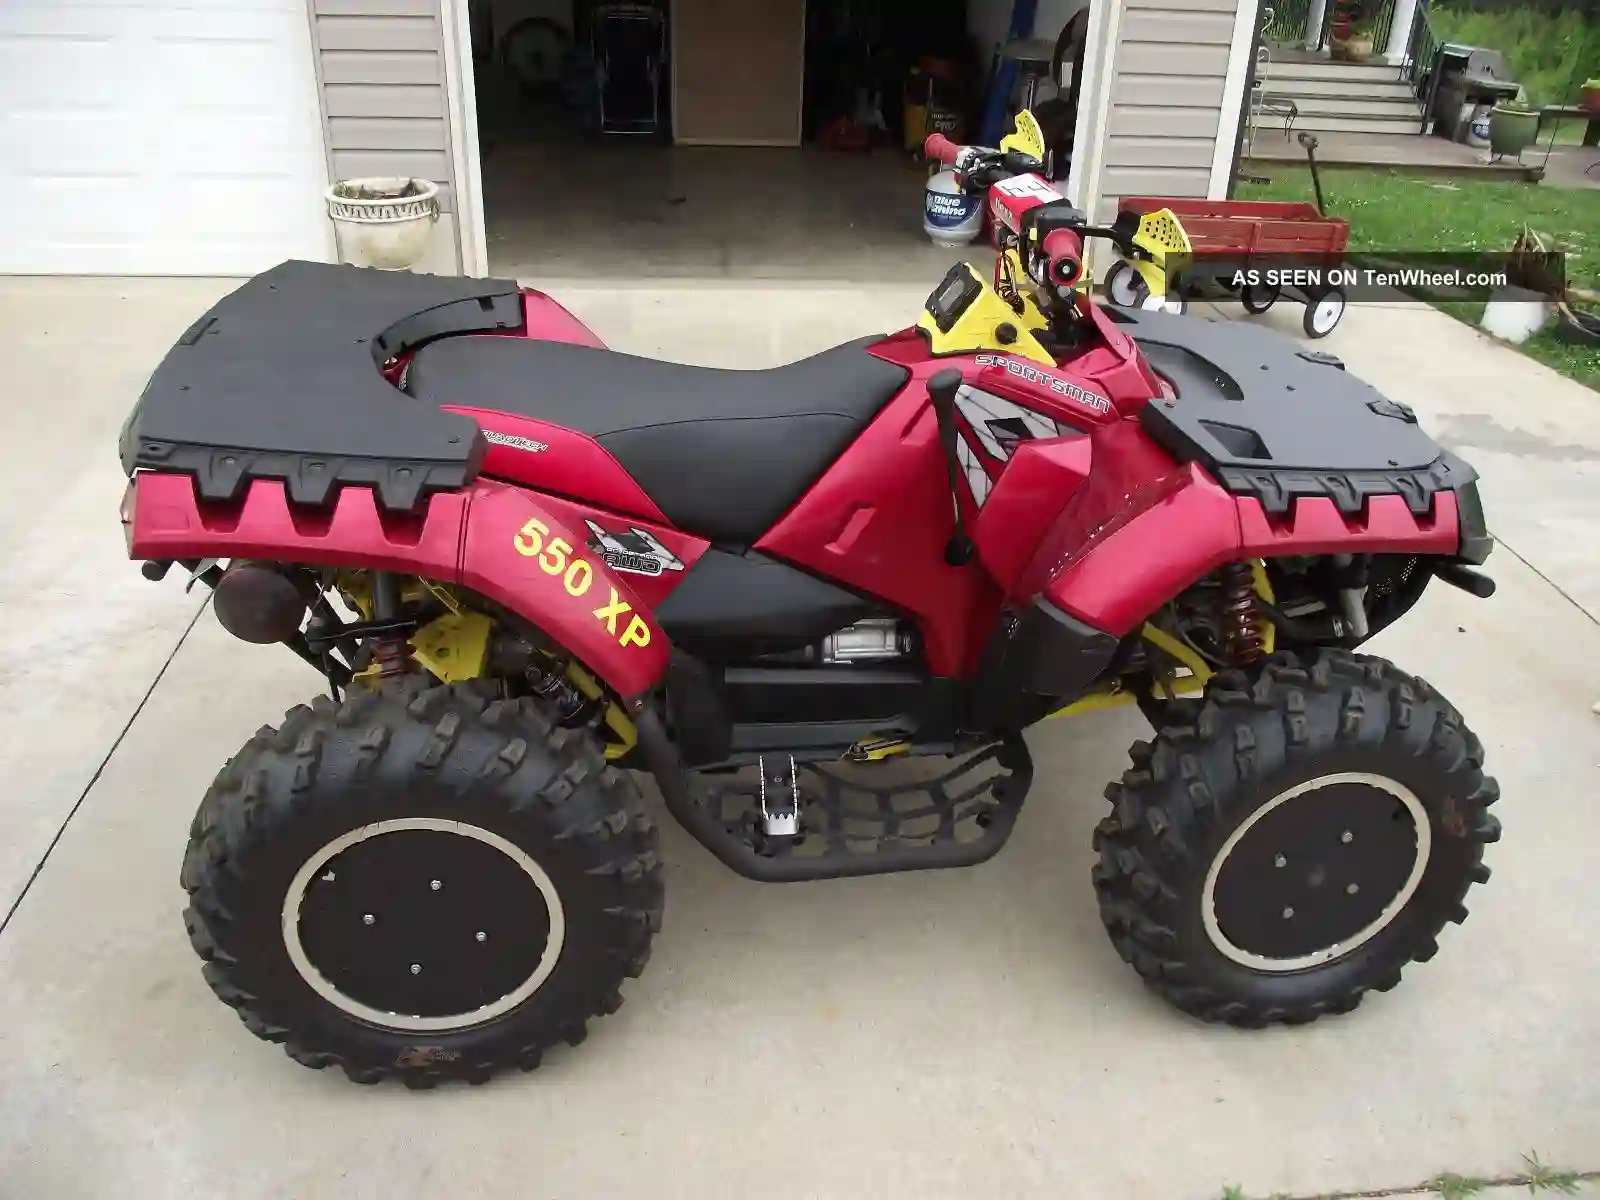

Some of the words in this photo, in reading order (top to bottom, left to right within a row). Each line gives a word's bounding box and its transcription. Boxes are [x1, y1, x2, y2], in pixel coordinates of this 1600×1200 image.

[975, 354, 1110, 414] SPORTSMAN
[513, 518, 593, 597] 550
[592, 586, 651, 648] XP
[605, 552, 662, 575] AWD
